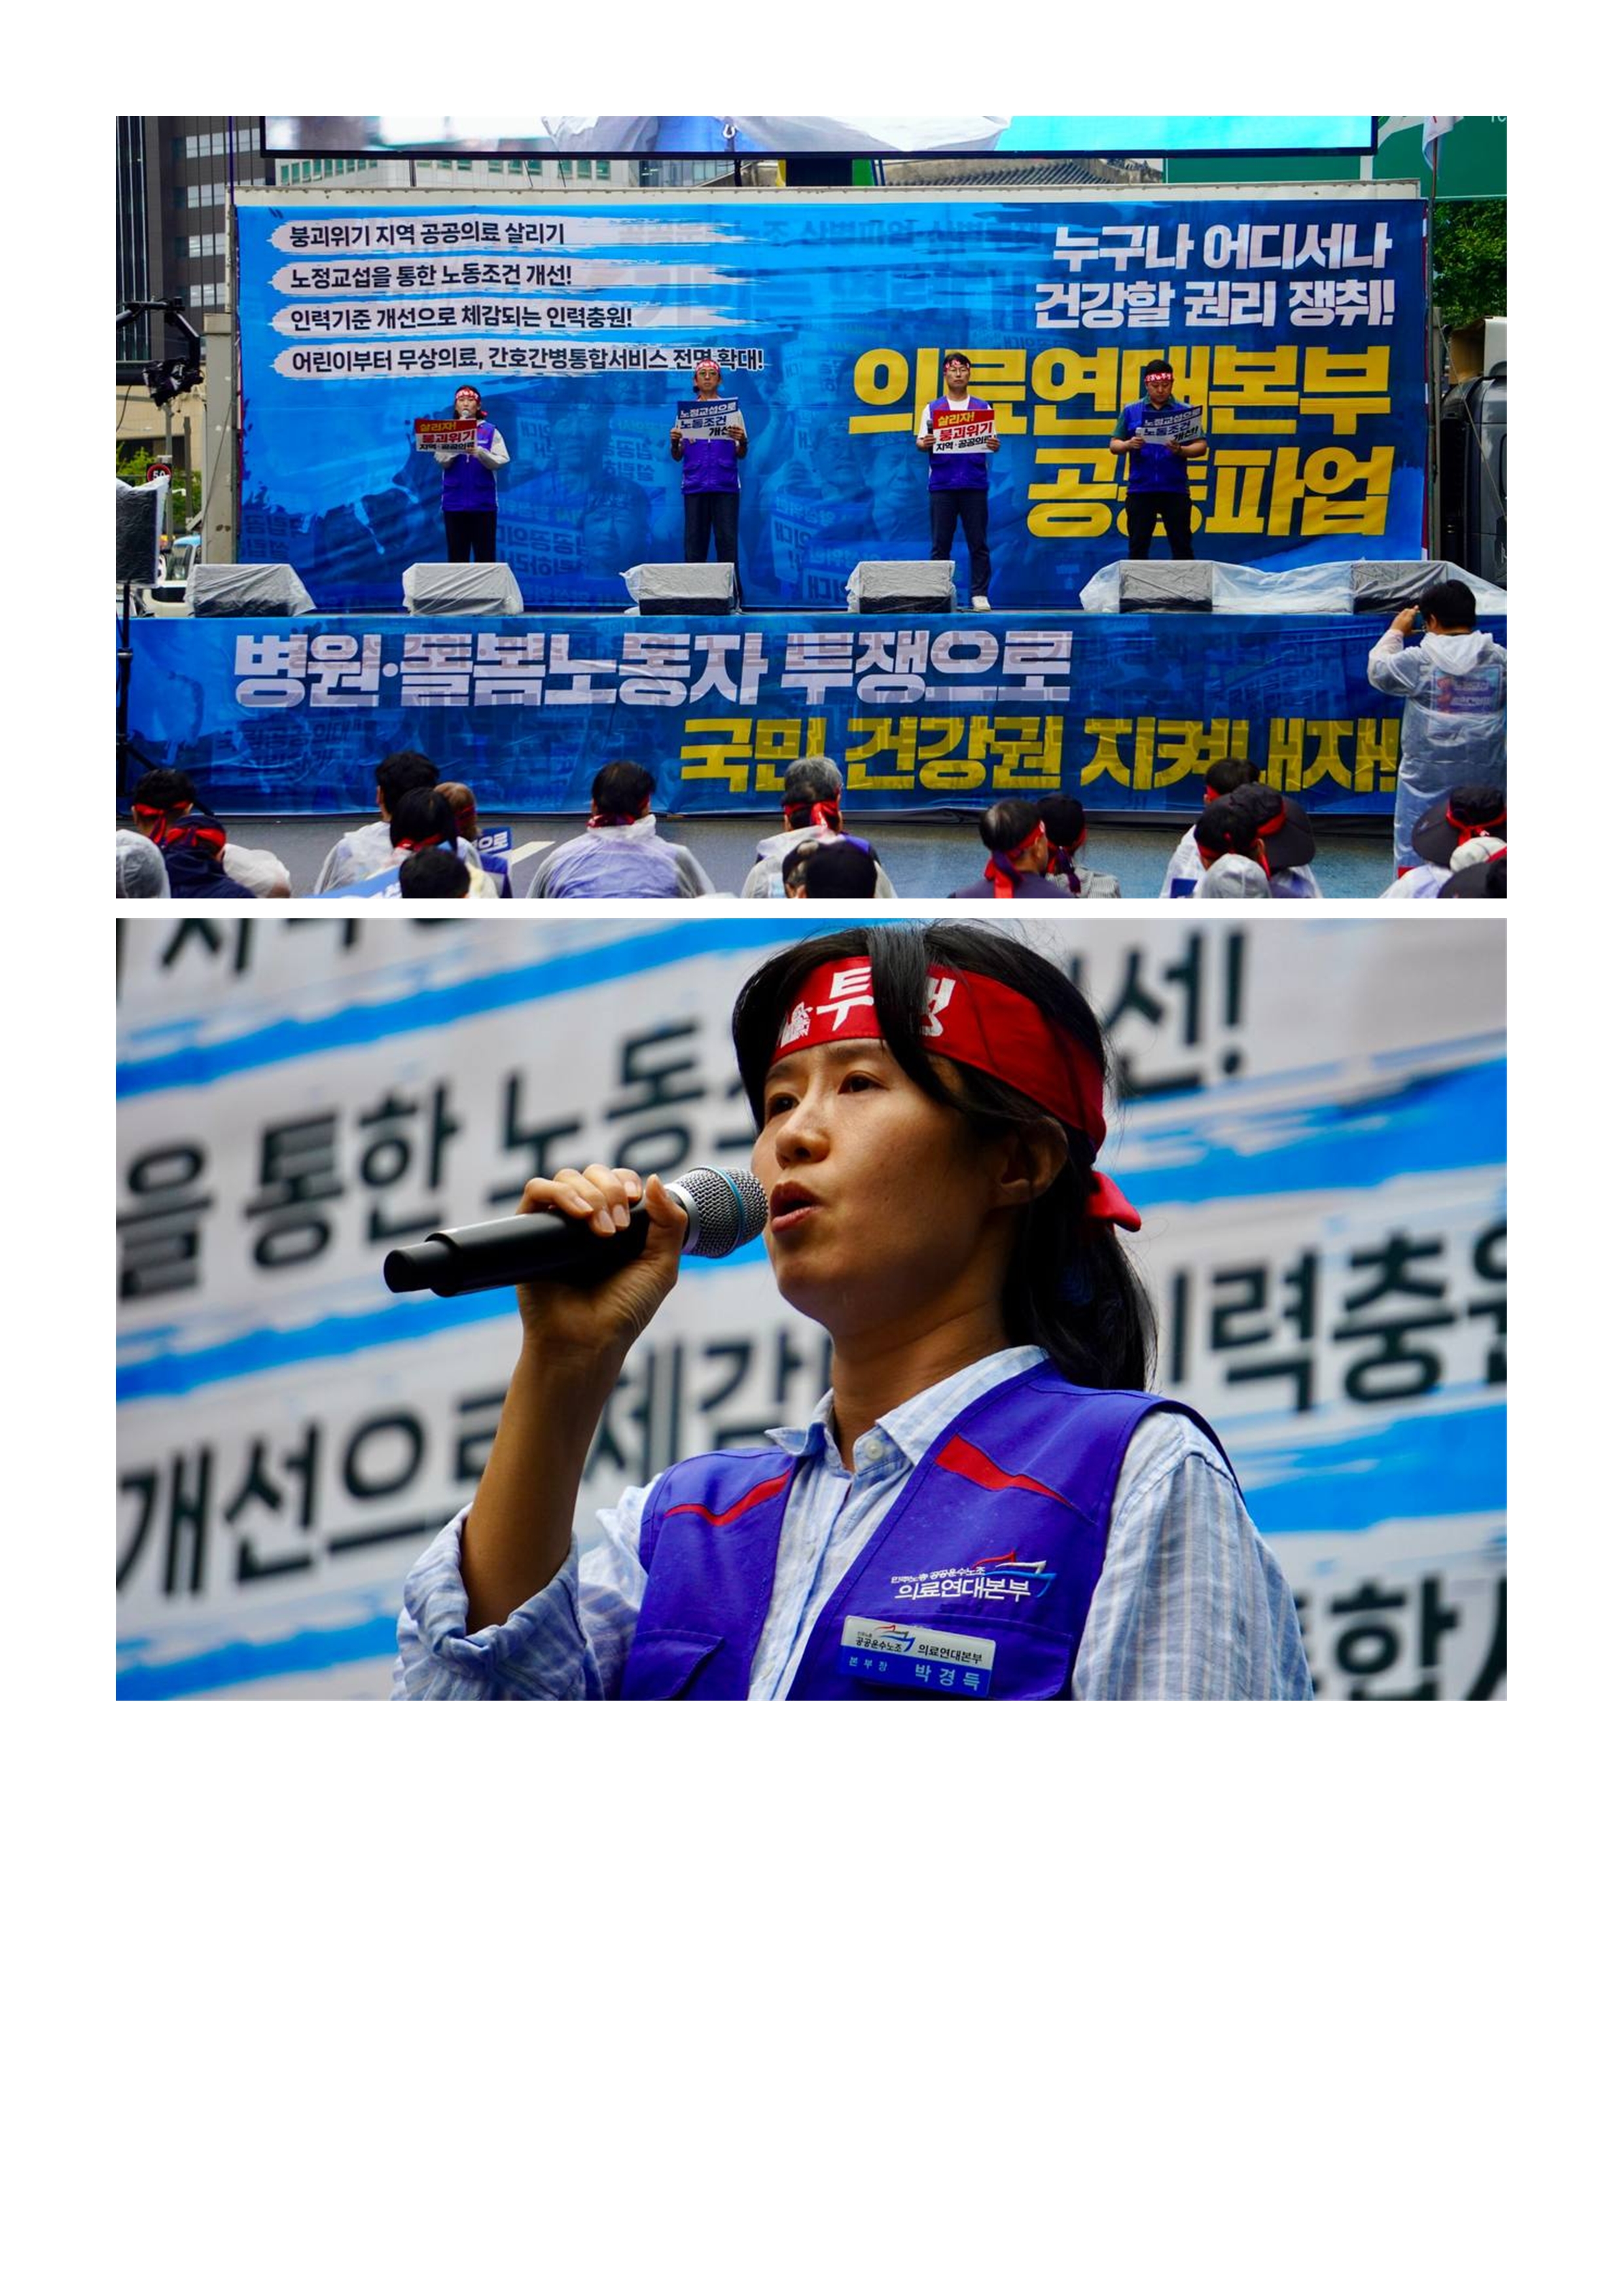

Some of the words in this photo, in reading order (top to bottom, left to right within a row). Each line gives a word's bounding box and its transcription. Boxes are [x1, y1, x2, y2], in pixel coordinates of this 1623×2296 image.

[289, 224, 370, 248] 붕괴위기
[376, 224, 415, 246] 지역
[420, 223, 501, 245] 공공의료
[505, 222, 565, 245] 살리기
[1052, 223, 1194, 272] 누구나
[1203, 222, 1393, 270] 어디서나
[291, 266, 391, 289] 노정교섭을
[396, 264, 437, 287] 통한
[441, 263, 521, 286] 노동조건
[526, 263, 573, 285] 개선!
[1035, 279, 1175, 329] 건강할
[1183, 279, 1277, 327] 권리
[1288, 279, 1395, 327] 쟁취!
[291, 308, 372, 332] 인력기준
[376, 307, 457, 329] 개선으로
[461, 306, 541, 327] 체감되는
[546, 306, 633, 328] 인력충원!
[292, 350, 393, 373] 어린이부터
[397, 348, 484, 370] 무상의료,
[488, 347, 668, 370] 간호간병통합서비스
[716, 348, 764, 370] 확대!
[680, 402, 737, 418] 노정교섭으로
[937, 412, 975, 427] 살리자!
[681, 416, 726, 429] 노동조건
[939, 422, 993, 442] 붕괴위기
[1144, 420, 1190, 436] 노동조건
[422, 430, 476, 444] 붕괴위기
[781, 630, 1074, 705] 투쟁으로
[680, 717, 827, 793] 국민
[846, 715, 1065, 790] 건강권
[473, 831, 508, 853] 으로
[242, 1075, 463, 1271] 통한
[1069, 925, 1248, 1098] 선!
[929, 1566, 986, 1580] 공공운수노조
[895, 1577, 1031, 1603] 의료연대본부
[855, 1636, 902, 1653] 공공운수노조
[918, 1643, 983, 1664] 의료연대본부
